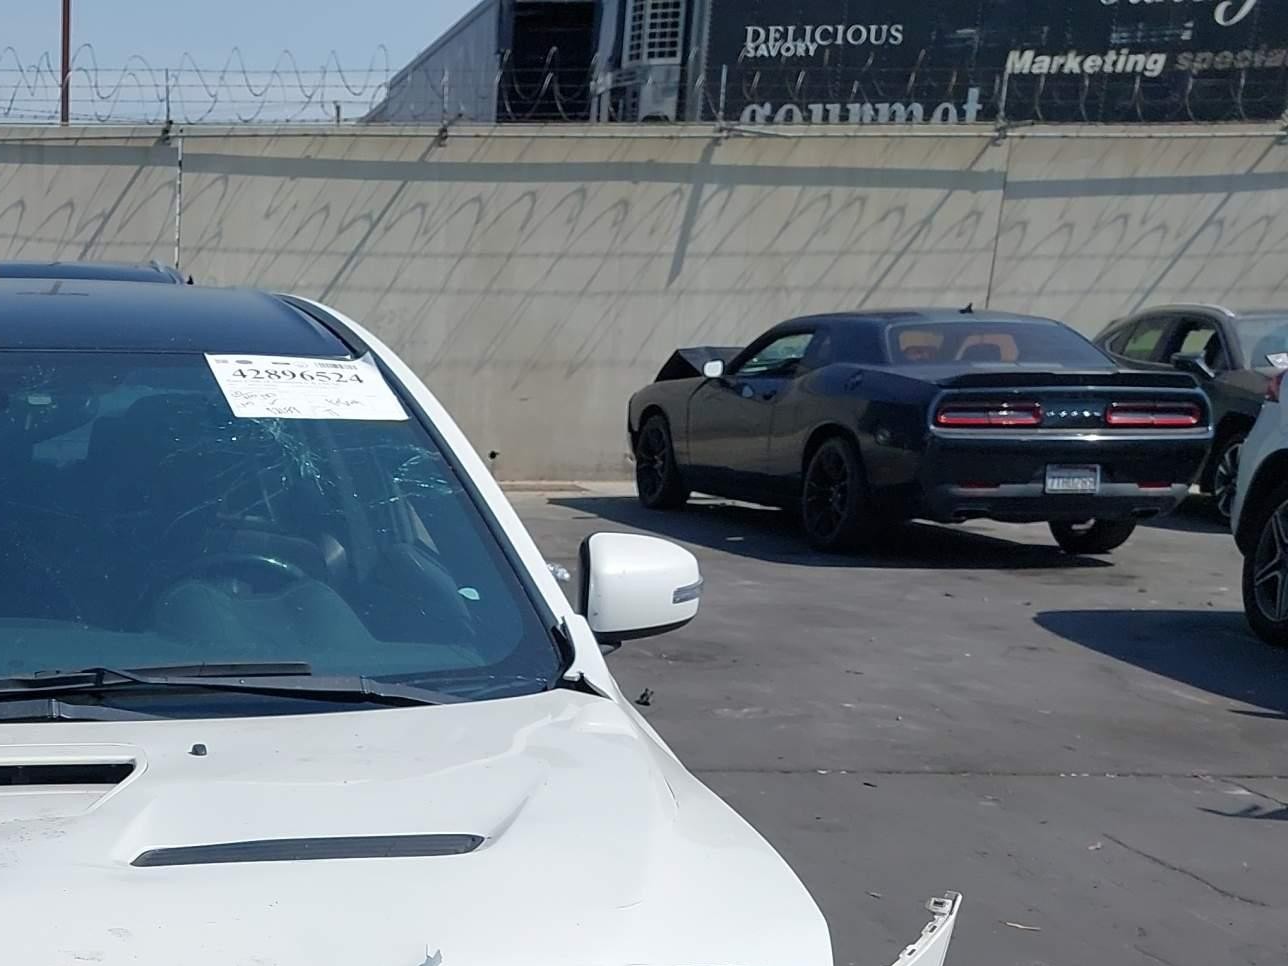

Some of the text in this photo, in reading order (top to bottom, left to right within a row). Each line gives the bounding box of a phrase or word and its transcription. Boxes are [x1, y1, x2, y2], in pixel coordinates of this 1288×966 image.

[744, 24, 904, 47] DELICIOUS
[744, 41, 818, 57] SAVORY
[1006, 45, 1288, 77] Marketing specia
[231, 367, 364, 384] 42896524
